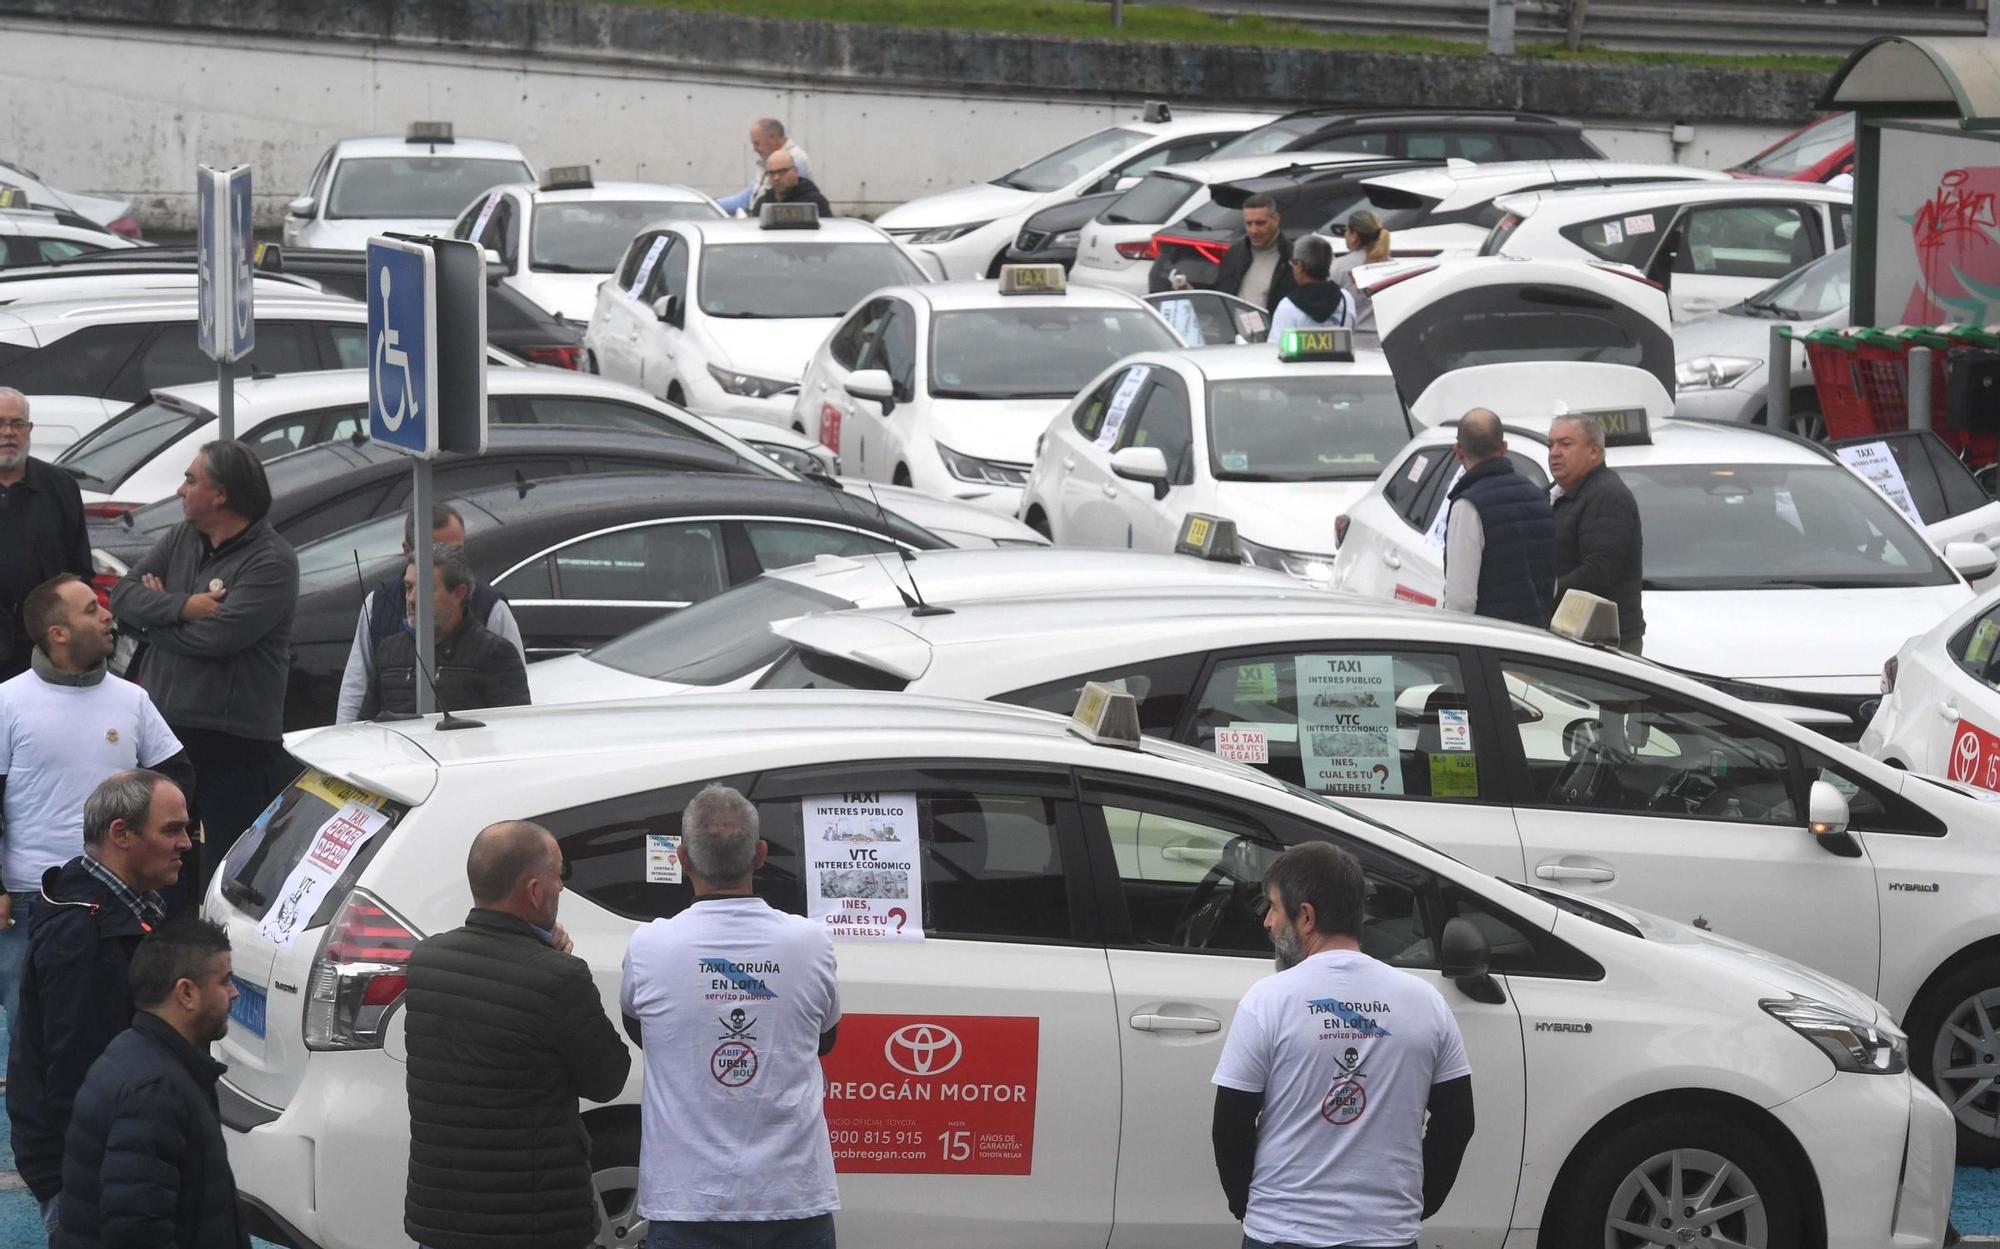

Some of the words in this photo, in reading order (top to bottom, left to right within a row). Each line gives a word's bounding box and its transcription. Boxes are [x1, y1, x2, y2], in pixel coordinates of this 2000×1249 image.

[1016, 269, 1048, 284] TAXI
[1300, 332, 1333, 350] TAXI
[1597, 413, 1625, 432] AXI
[1856, 447, 1875, 458] TAXI
[1327, 660, 1362, 673] TAXI
[1308, 676, 1344, 684] INTERES
[1346, 676, 1383, 685] PUBLICO
[1336, 714, 1361, 726] VTC
[1306, 725, 1340, 733] INTERES
[1341, 725, 1389, 734] ECONOMICO
[1219, 732, 1229, 743] SI
[1242, 733, 1264, 744] TAXI
[1331, 758, 1358, 768] INES,
[1319, 771, 1344, 779] CUAL
[1346, 771, 1358, 779] ES
[1360, 771, 1373, 779] TU
[1986, 753, 2000, 789] 15
[1326, 783, 1372, 793] INTERES?
[842, 792, 880, 803] TAXI
[348, 808, 370, 826] TAXI
[817, 807, 858, 816] INTERES
[861, 807, 904, 816] PUBLICO
[849, 849, 878, 860] VTC
[815, 861, 853, 869] INTERES
[856, 862, 911, 870] ECONOMICO
[301, 875, 316, 893] VTC
[1889, 883, 1932, 892] HYBRID
[842, 900, 871, 911] INES,
[825, 915, 854, 924] CUAL
[857, 916, 870, 924] ES
[873, 916, 888, 925] TU
[833, 927, 886, 936] INTERES?
[699, 963, 725, 973] TAXI
[729, 960, 780, 973] CORUÑA
[712, 980, 728, 990] EN
[732, 980, 766, 990] LOITA
[705, 992, 737, 1000] servizo
[1307, 1003, 1335, 1014] TAXI
[1338, 1001, 1391, 1013] CORUÑA
[1324, 1019, 1340, 1029] EN
[1344, 1019, 1378, 1029] LOITA
[1535, 1022, 1584, 1033] HYBRID
[1319, 1031, 1349, 1040] servizo
[719, 1059, 747, 1068] UBER
[823, 1079, 931, 1101] REOGÁN
[941, 1084, 1026, 1102] MOTOR
[830, 1131, 858, 1144] 900
[864, 1131, 891, 1144] 815
[896, 1131, 922, 1144] 915
[980, 1133, 1003, 1142] AÑOS
[1005, 1134, 1016, 1142] DE
[938, 1131, 971, 1161] 15
[832, 1147, 926, 1161] pobreogan.com
